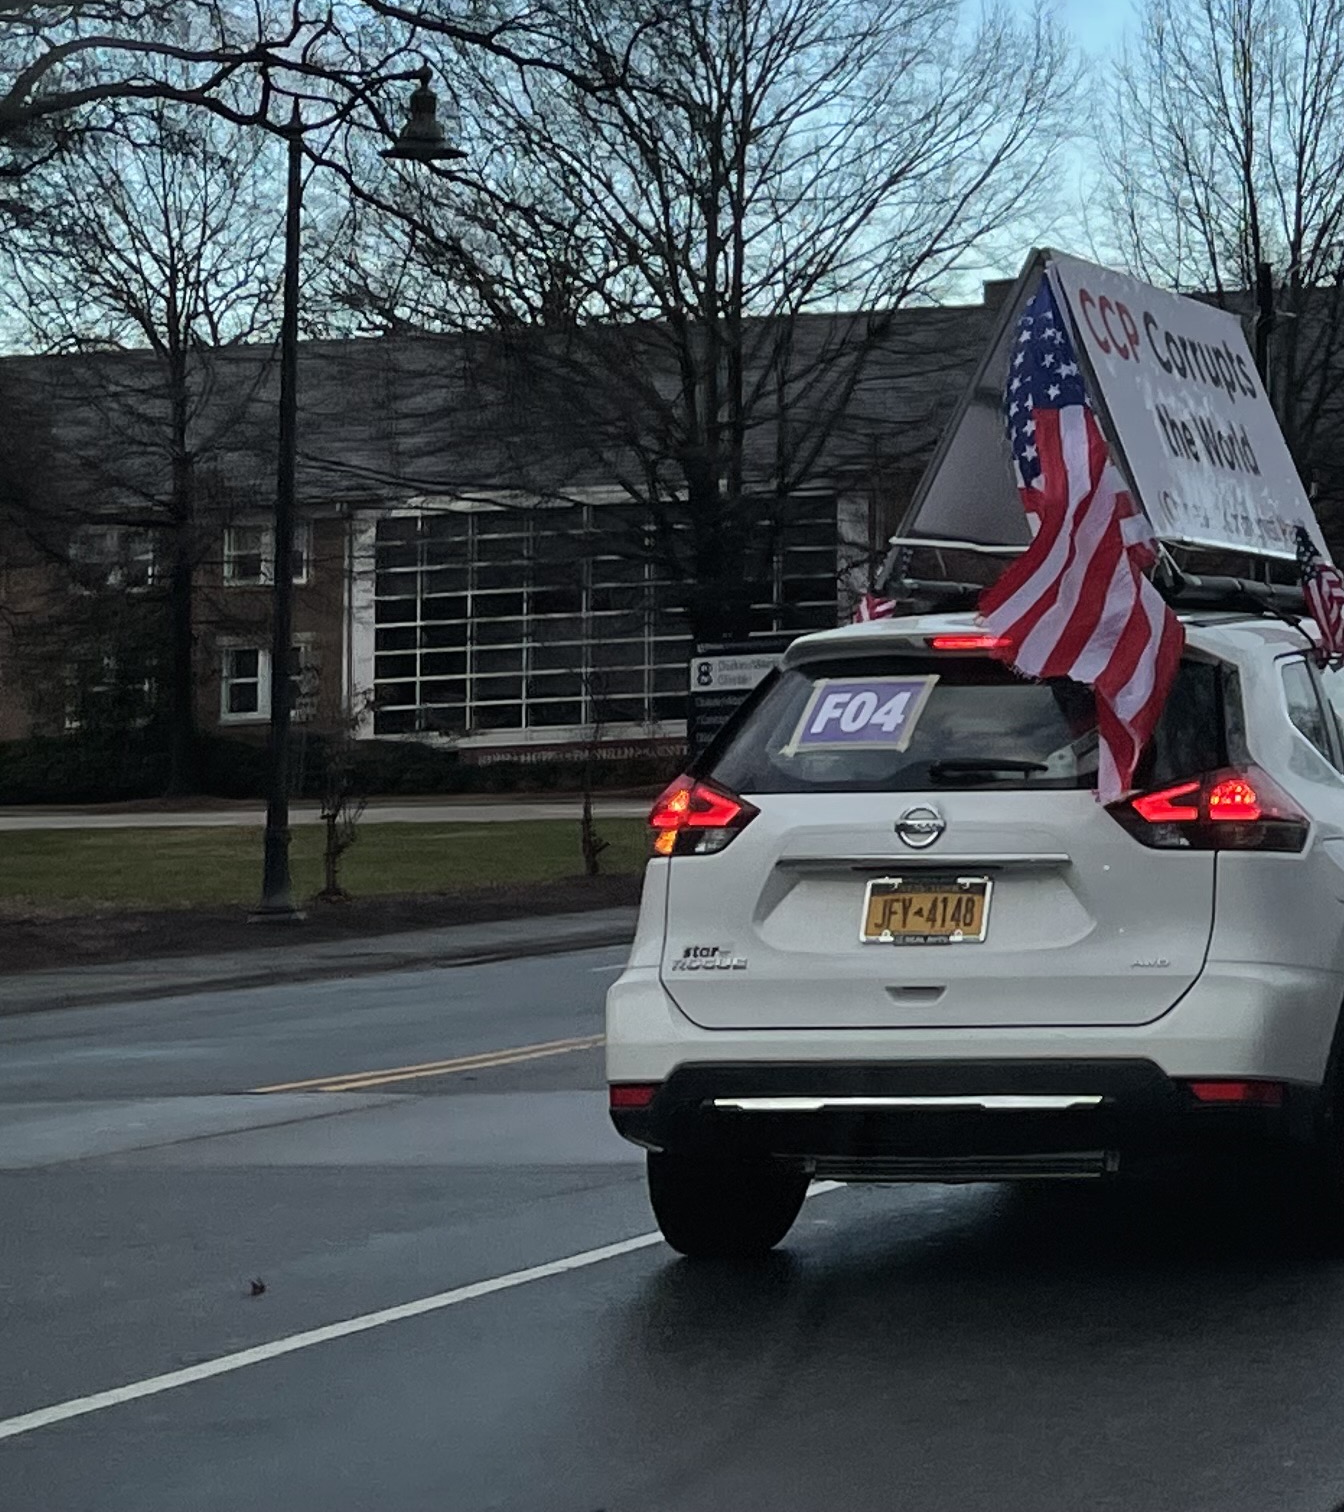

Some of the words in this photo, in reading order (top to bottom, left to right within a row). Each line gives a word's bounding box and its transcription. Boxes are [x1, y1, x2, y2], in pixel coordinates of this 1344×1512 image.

[1078, 287, 1140, 364] CCP
[1142, 310, 1257, 404] Corrupts
[1154, 403, 1201, 463] the
[1189, 411, 1262, 476] World
[809, 691, 912, 735] F04
[873, 897, 913, 930] JFY
[925, 895, 976, 929] 4148
[671, 958, 748, 972] ROGUE
[682, 945, 719, 959] star
